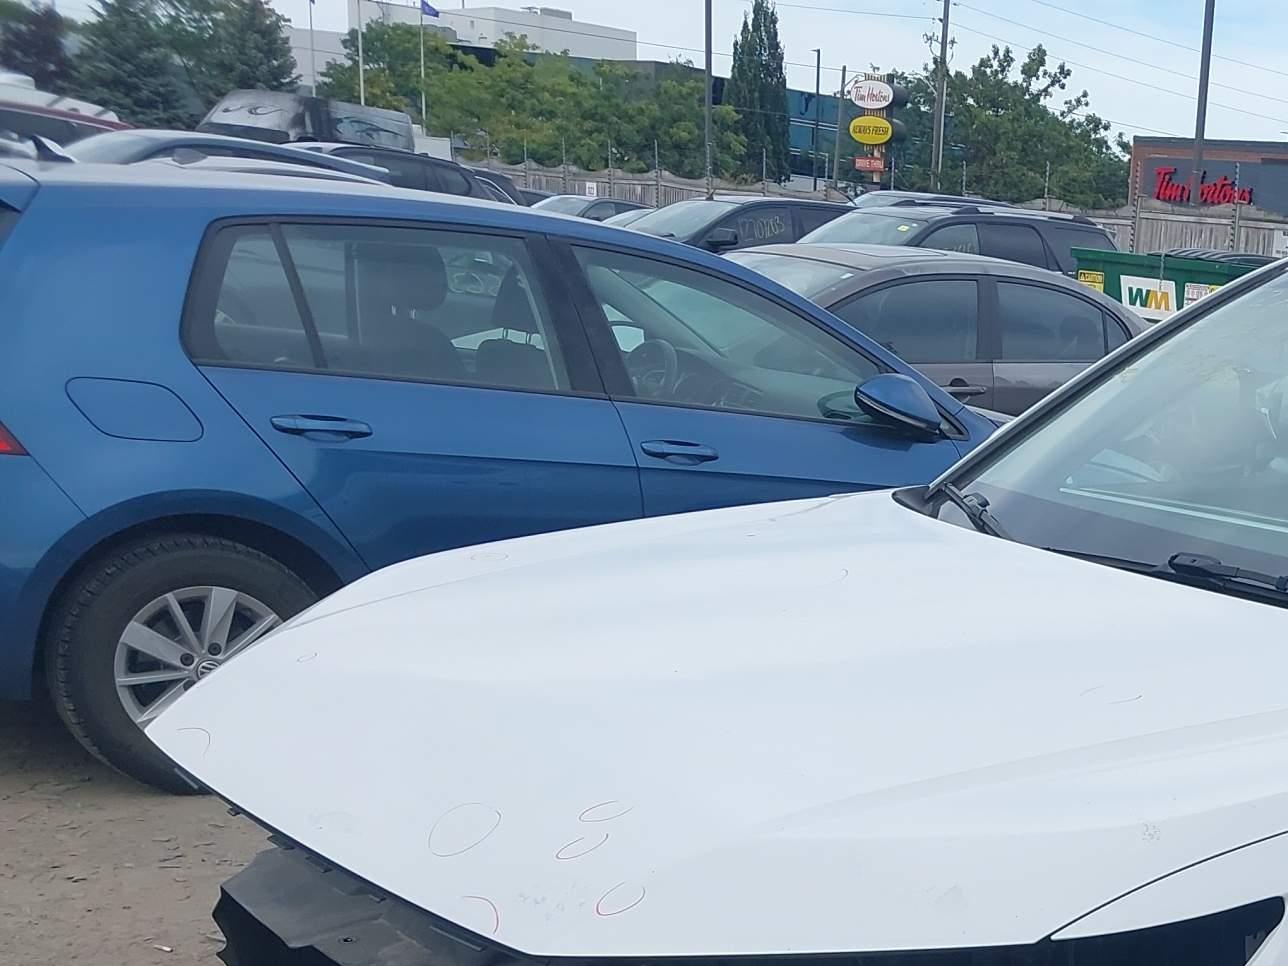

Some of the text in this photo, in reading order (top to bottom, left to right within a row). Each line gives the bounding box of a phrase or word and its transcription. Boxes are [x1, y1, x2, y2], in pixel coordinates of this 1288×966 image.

[854, 85, 890, 103] Tim Hortons
[871, 126, 889, 136] FRESH
[856, 159, 884, 169] DRIVE THRU
[1154, 167, 1182, 201] Tim
[1128, 286, 1170, 311] WM
